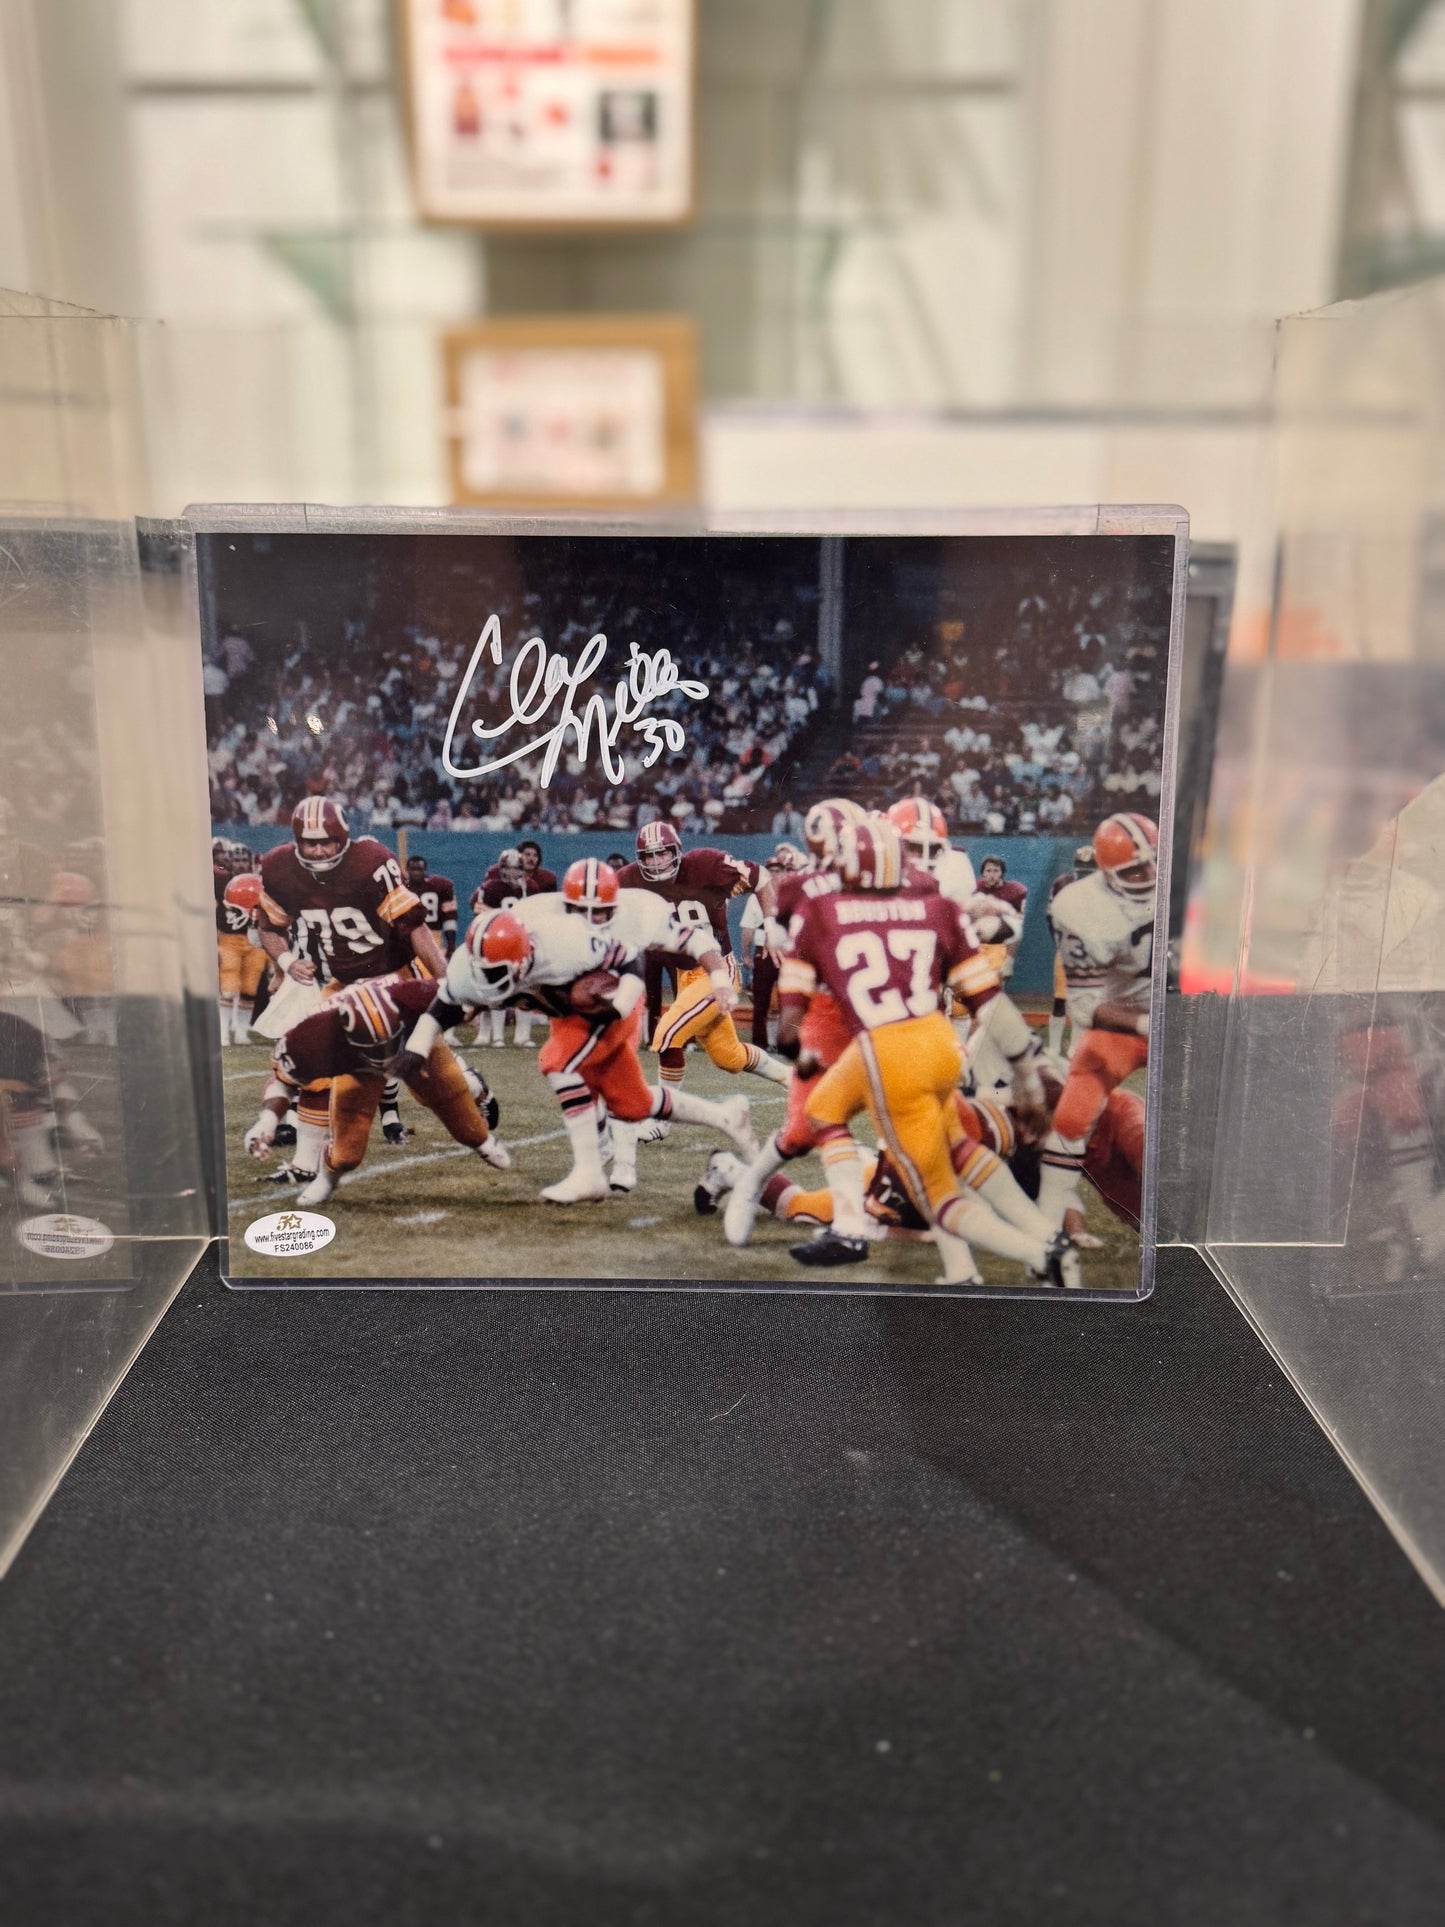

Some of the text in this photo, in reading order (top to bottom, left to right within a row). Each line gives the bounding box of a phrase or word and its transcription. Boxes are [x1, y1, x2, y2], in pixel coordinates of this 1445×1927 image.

[633, 717, 686, 768] 30
[372, 858, 403, 893] 79
[300, 906, 385, 957] 79
[835, 929, 938, 1029] 27
[254, 1228, 330, 1243] www.fivestargrading.com
[274, 1241, 314, 1253] FS240086
